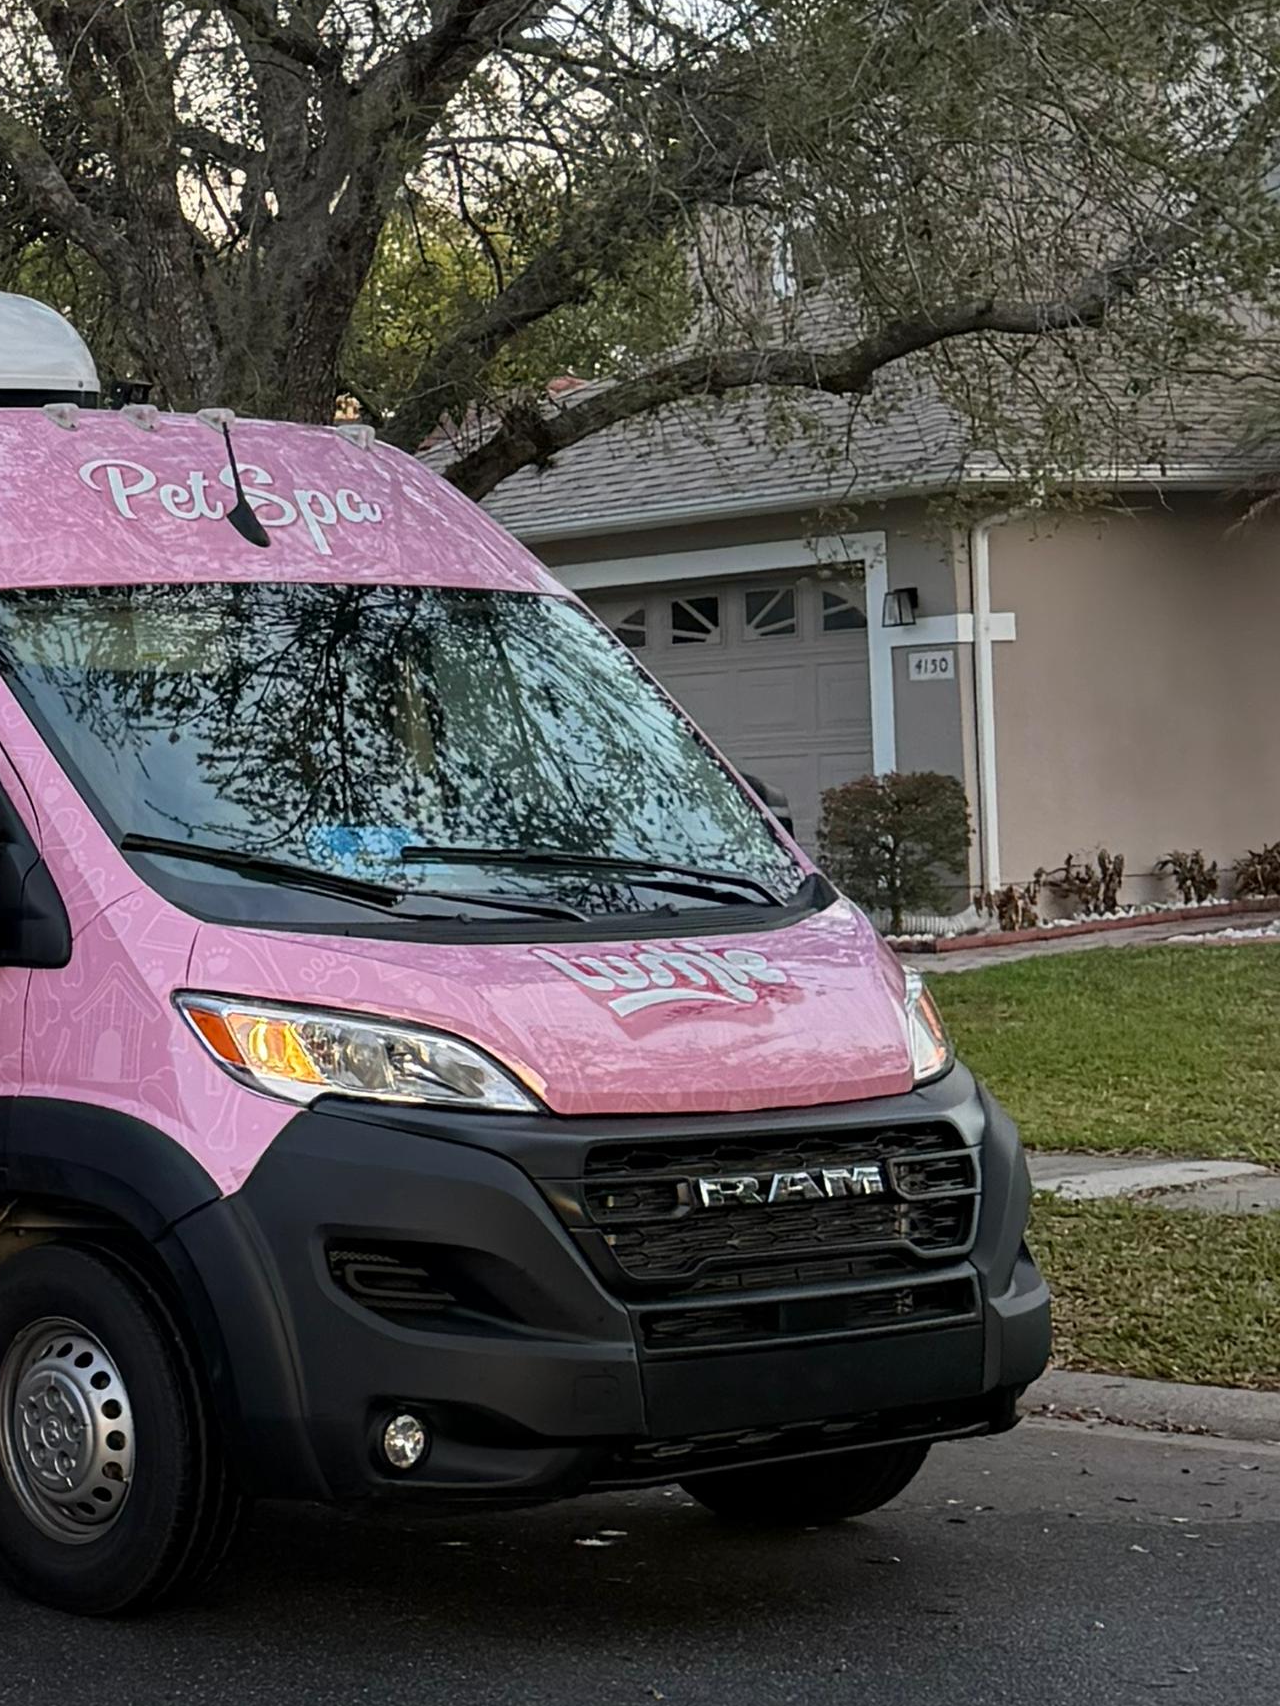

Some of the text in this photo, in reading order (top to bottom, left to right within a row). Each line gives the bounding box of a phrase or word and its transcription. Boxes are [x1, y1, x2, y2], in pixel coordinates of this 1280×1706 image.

[79, 458, 383, 555] Pet Spa
[914, 657, 949, 674] 4150
[529, 941, 788, 1003] Lushie
[697, 1165, 885, 1208] RAM
